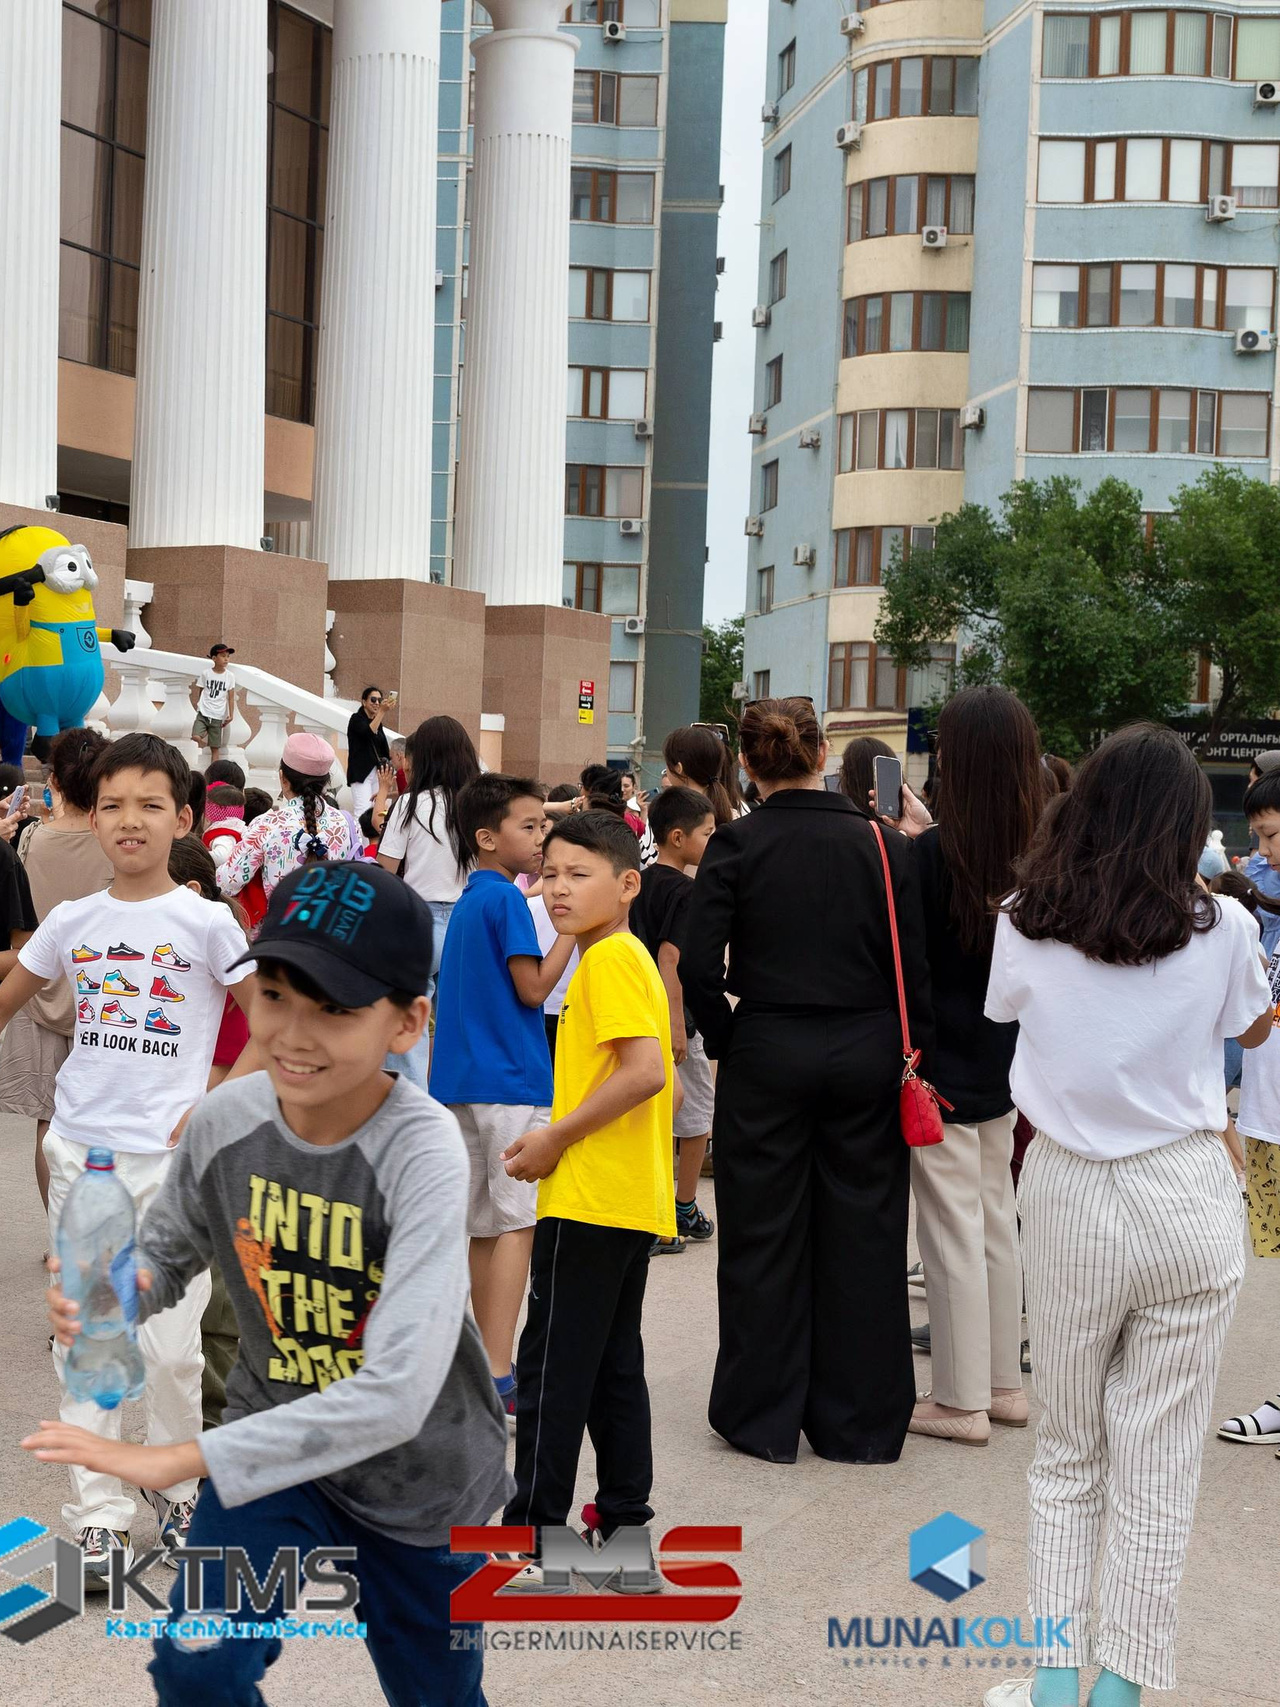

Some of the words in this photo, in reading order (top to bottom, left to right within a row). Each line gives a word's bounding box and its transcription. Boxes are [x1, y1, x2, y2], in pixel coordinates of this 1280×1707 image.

[206, 680, 226, 691] LEVEL
[209, 690, 220, 698] UP
[103, 1033, 138, 1052] LOOK
[142, 1039, 179, 1057] BACK
[249, 1173, 364, 1272] INTO
[259, 1269, 358, 1339] THE
